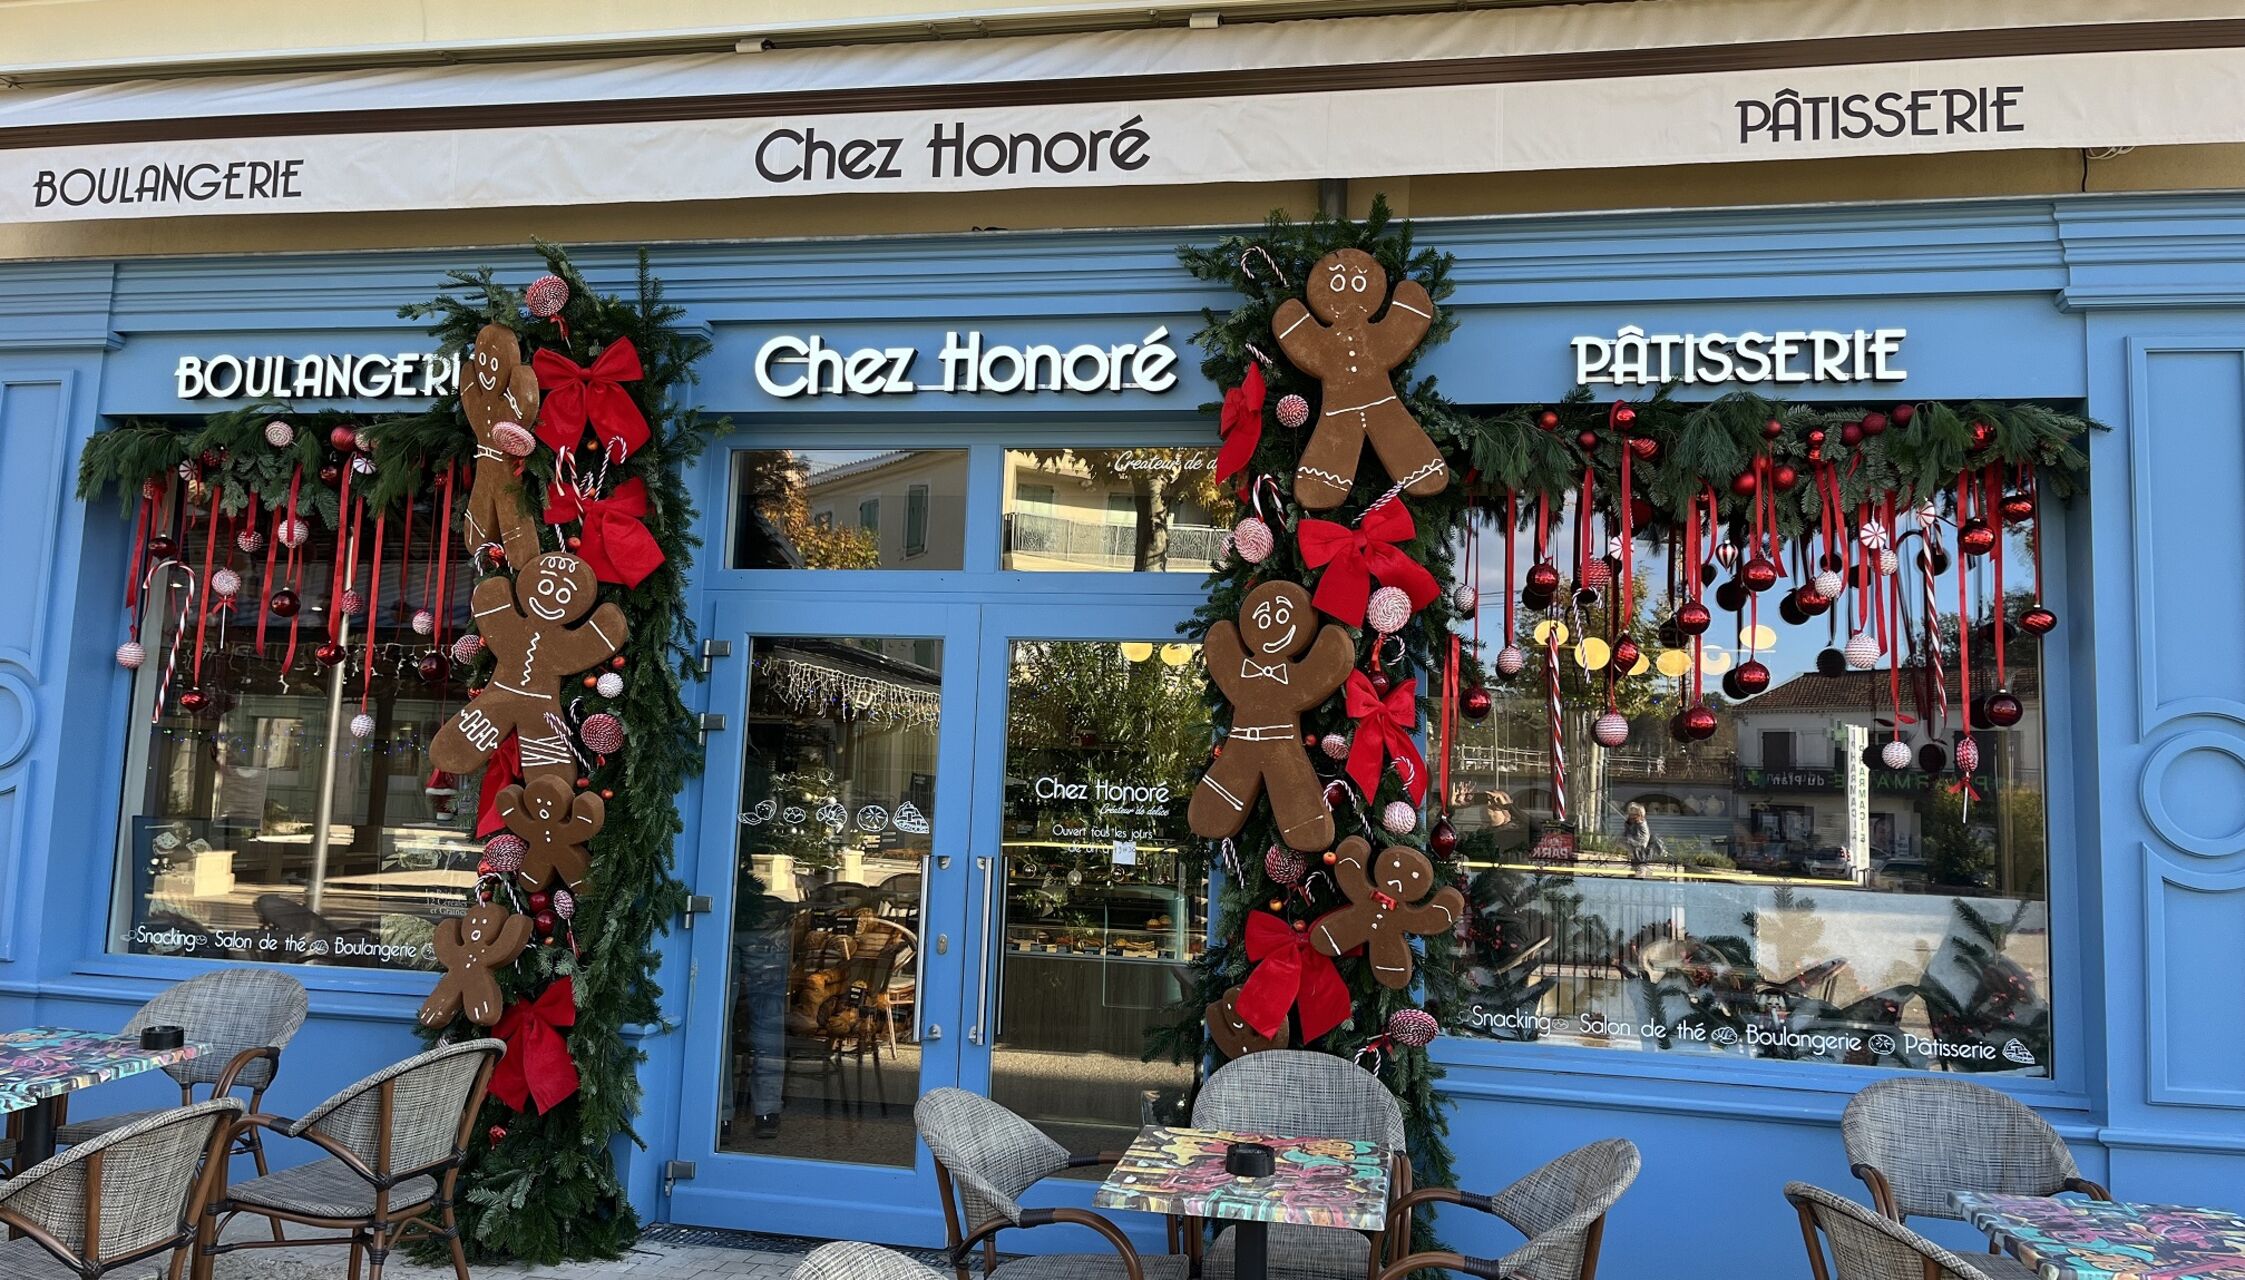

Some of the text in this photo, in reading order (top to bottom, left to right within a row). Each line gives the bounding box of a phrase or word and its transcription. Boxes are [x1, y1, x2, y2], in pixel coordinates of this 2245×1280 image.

[1735, 86, 2024, 143] PÂTISSERIE
[755, 115, 1150, 182] Chez Honoré
[33, 159, 304, 207] BOULANGERIE
[174, 352, 475, 399] BOULANGERI
[755, 325, 1177, 398] Chez Honoré
[1570, 325, 1907, 385] PÂTISSERIE
[1184, 452, 1202, 469] de
[1035, 777, 1170, 803] Chez Honoré
[1053, 824, 1153, 841] Ouvert tous les jours
[137, 926, 417, 962] Snacking Salon de thé Boulangerie
[1472, 1005, 1997, 1060] Snacking Salon de thé Boulangerie Pâtisserie
